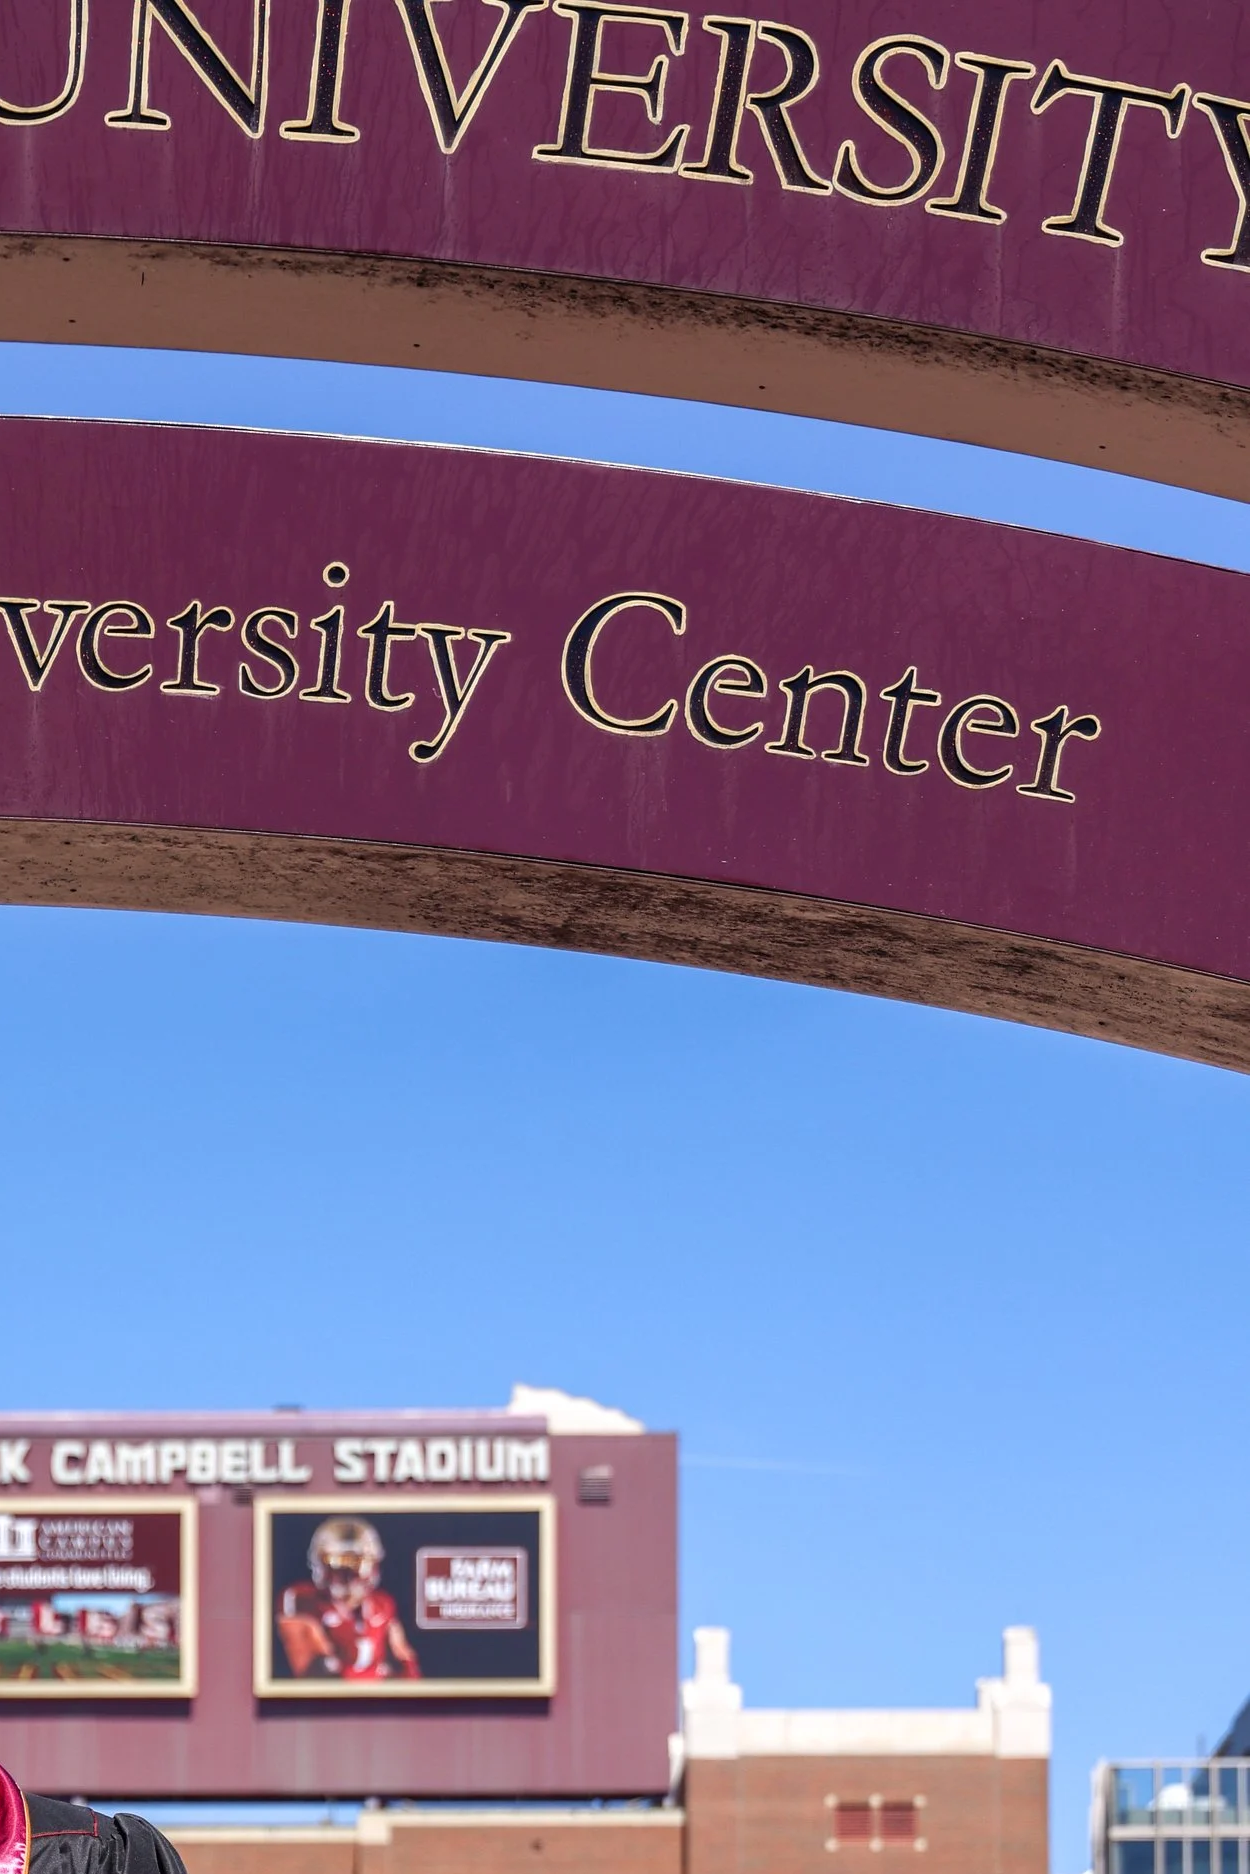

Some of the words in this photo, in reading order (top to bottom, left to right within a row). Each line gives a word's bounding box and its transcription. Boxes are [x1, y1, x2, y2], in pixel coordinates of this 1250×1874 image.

[560, 590, 1102, 803] Center
[50, 1439, 313, 1486] CAMPBELL
[332, 1437, 550, 1483] STADIUM
